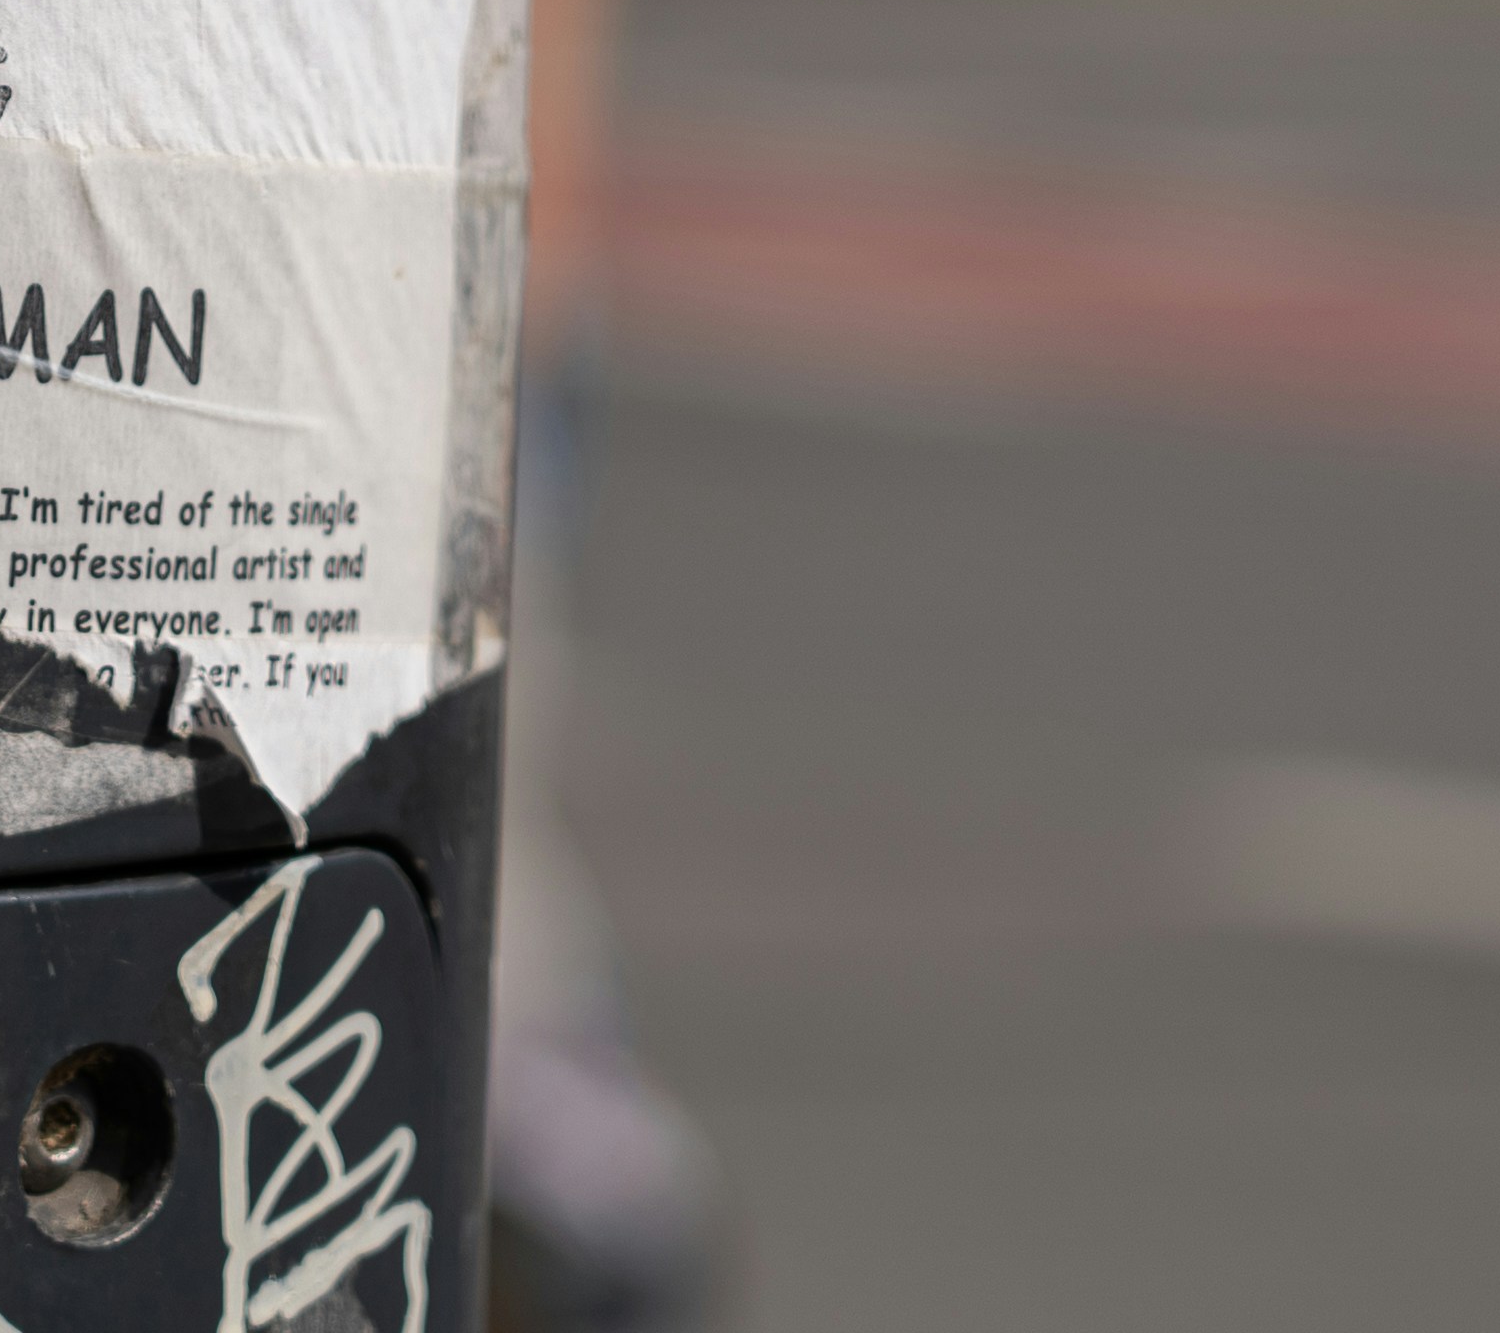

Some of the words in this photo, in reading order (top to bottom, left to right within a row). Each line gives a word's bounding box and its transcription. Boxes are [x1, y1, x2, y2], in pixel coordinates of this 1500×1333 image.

[77, 490, 164, 527] tired
[178, 490, 214, 527] of
[228, 490, 274, 526] the
[287, 489, 359, 535] single
[8, 543, 219, 588] professional
[231, 546, 312, 582] artist
[322, 543, 367, 581] and
[26, 599, 56, 633] in
[74, 604, 231, 644] everyone.
[248, 599, 295, 635] I'm
[305, 604, 360, 643] open
[265, 653, 297, 689] If
[305, 661, 349, 697] you
